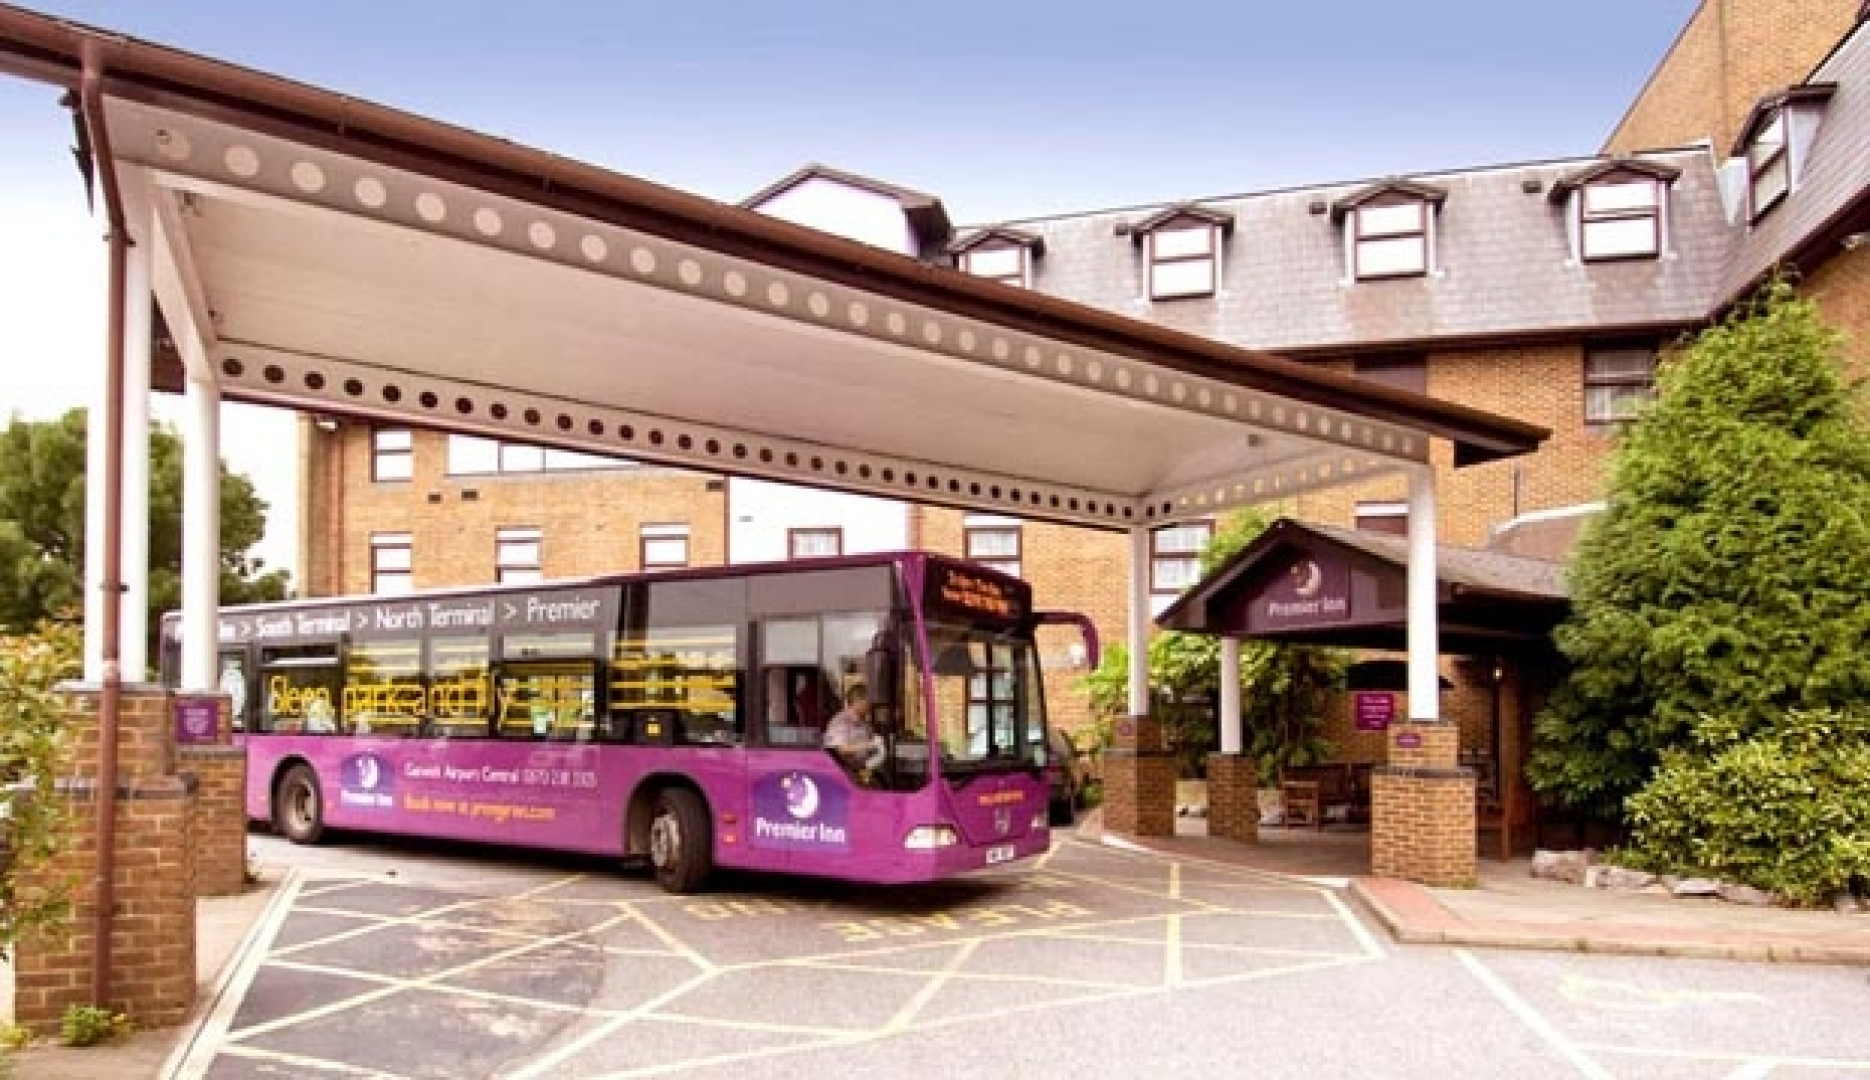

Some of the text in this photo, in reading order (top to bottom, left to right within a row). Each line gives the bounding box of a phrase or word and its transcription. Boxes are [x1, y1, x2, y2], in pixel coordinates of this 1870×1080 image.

[256, 616, 293, 637] South
[296, 609, 351, 635] Terminal
[376, 605, 423, 629] North
[427, 602, 496, 626] Terminal
[527, 597, 600, 622] Premier
[1268, 596, 1346, 617] Premier Inn
[444, 764, 480, 782] Airport
[756, 817, 845, 843] Premier Inn
